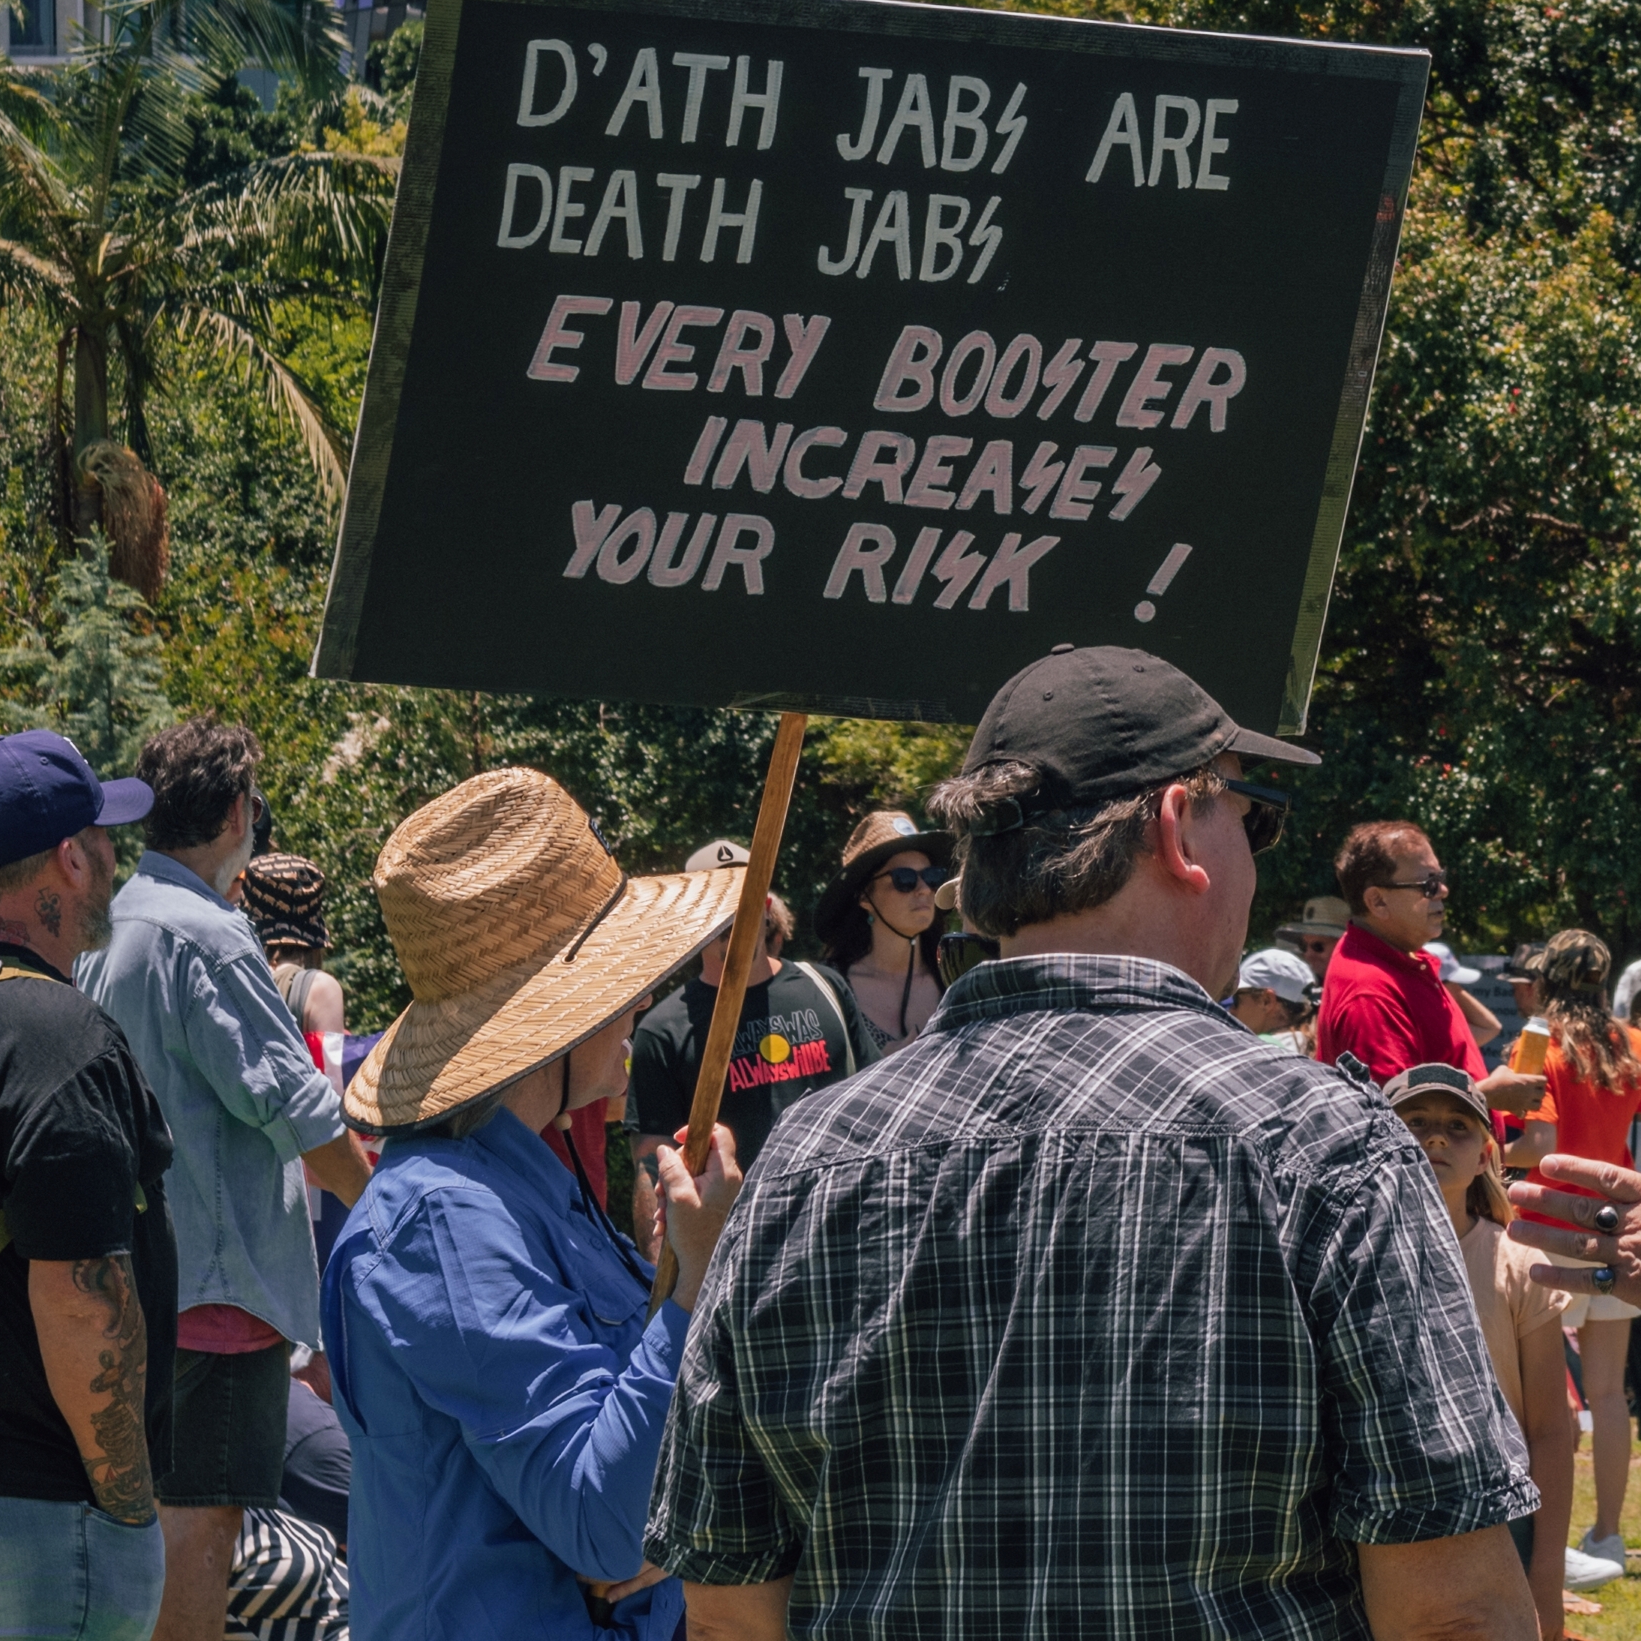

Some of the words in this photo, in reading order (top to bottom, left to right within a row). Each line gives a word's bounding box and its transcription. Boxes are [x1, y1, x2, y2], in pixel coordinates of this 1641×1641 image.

[517, 39, 783, 150] D'ATH
[837, 67, 1027, 174] JABS
[1085, 92, 1239, 190] ARE
[497, 163, 763, 263] DEATH
[818, 187, 1002, 283] JABS
[527, 295, 831, 398] EVERY
[873, 325, 1246, 432] BOOSTER
[684, 416, 1161, 521] INCREASES
[563, 500, 775, 594] YOUR
[823, 523, 1061, 611] RISK
[732, 1015, 782, 1057] LWAYS
